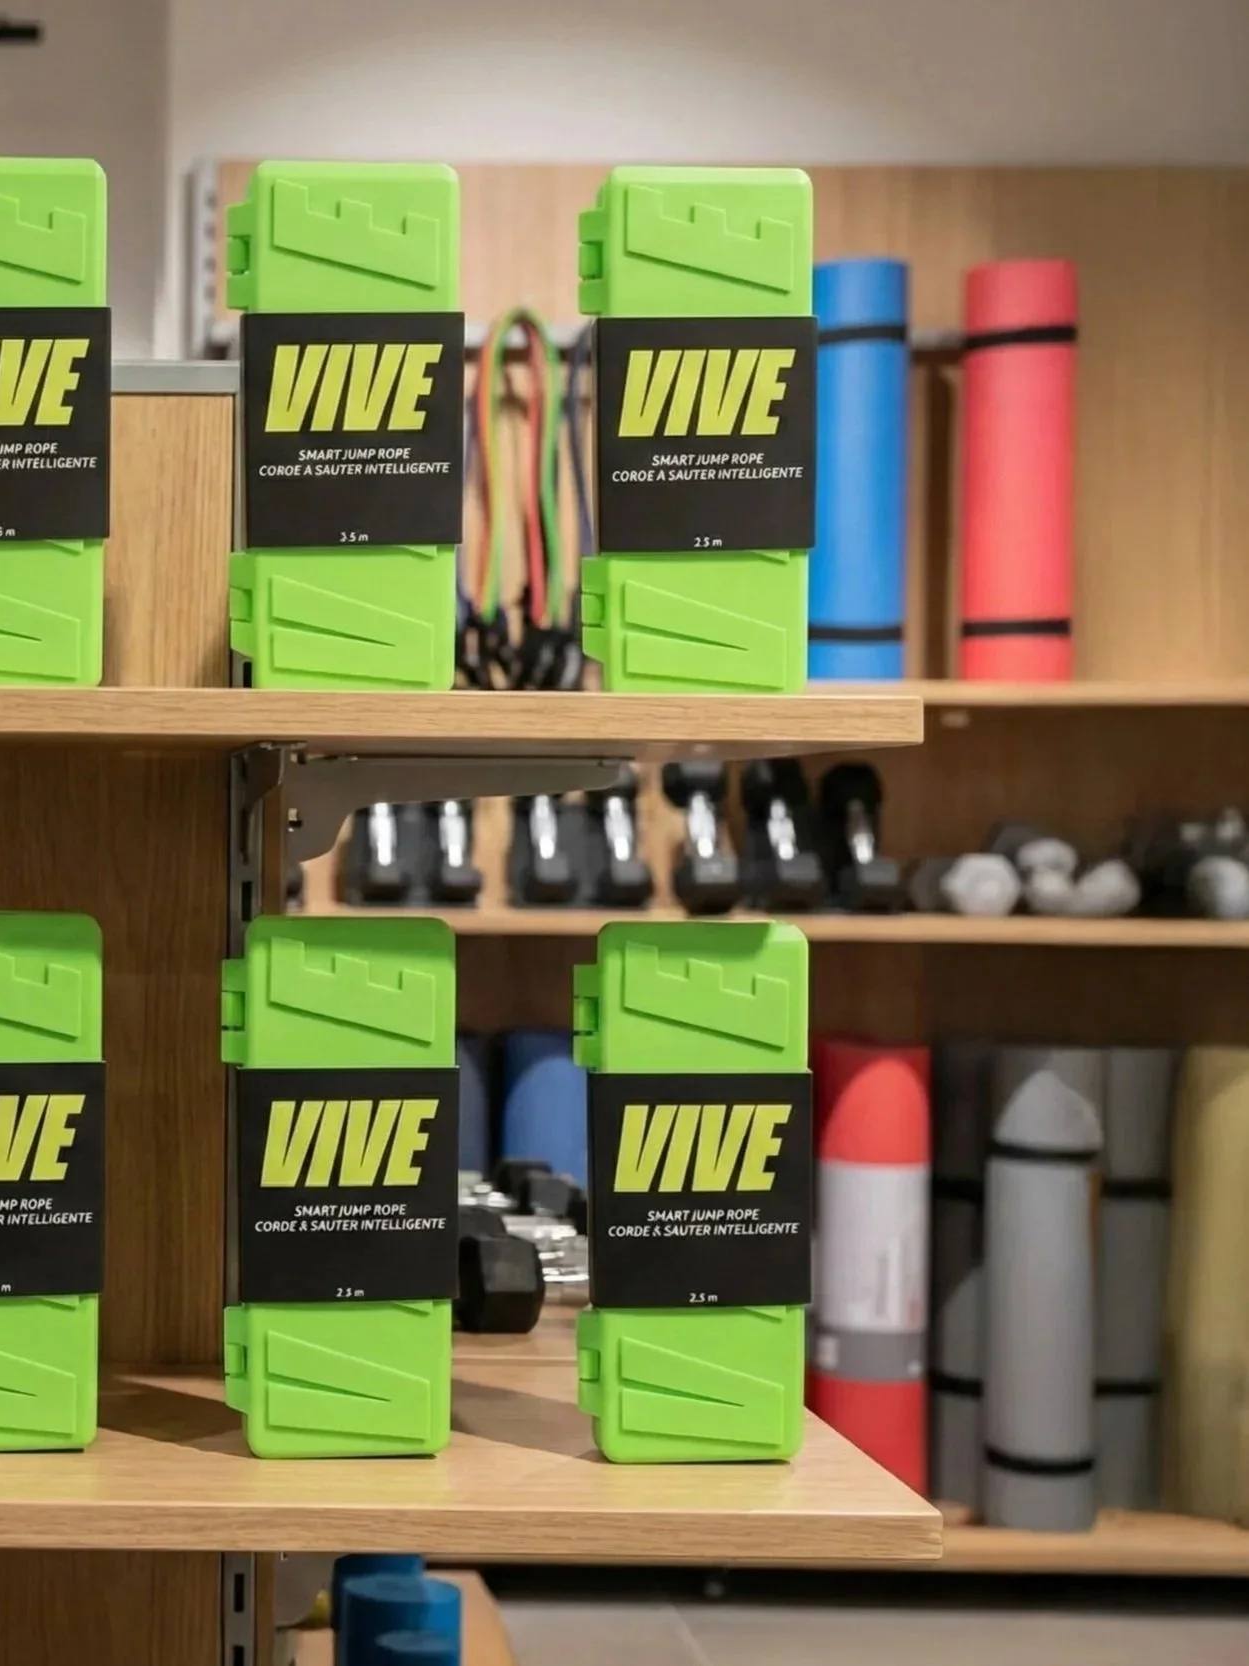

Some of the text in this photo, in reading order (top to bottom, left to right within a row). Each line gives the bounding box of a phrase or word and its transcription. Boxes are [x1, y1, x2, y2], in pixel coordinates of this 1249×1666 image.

[265, 344, 443, 432] VIVE
[618, 349, 796, 437] VIVE
[24, 443, 58, 454] ROPE
[298, 448, 412, 461] SMART JUMP ROPE
[11, 457, 98, 469] INTELLIGENTE
[651, 453, 765, 466] SMART JUMP ROPE
[314, 464, 363, 476] SAUTER
[364, 462, 451, 474] INTELLIGENTE
[667, 469, 717, 481] SAUTER
[717, 467, 804, 479] INTELLIGENTE
[4, 528, 16, 537] m
[357, 533, 369, 542] m
[711, 538, 723, 547] m
[261, 1099, 439, 1187] VIVE
[614, 1105, 792, 1192] VIVE
[19, 1198, 53, 1210] ROPE
[338, 1205, 372, 1217] JUMP
[373, 1204, 407, 1215] ROPE
[6, 1212, 93, 1225] INTELLIGENTE
[646, 1210, 690, 1221] SMART
[726, 1209, 760, 1220] ROPE
[310, 1220, 359, 1231] SAUTER
[360, 1218, 447, 1230] INTELLIGENTE
[663, 1225, 712, 1236] SAUTER
[713, 1223, 800, 1235] INTELLIGENTE
[0, 1284, 12, 1292] m
[354, 1289, 365, 1297] m
[707, 1294, 718, 1302] m
